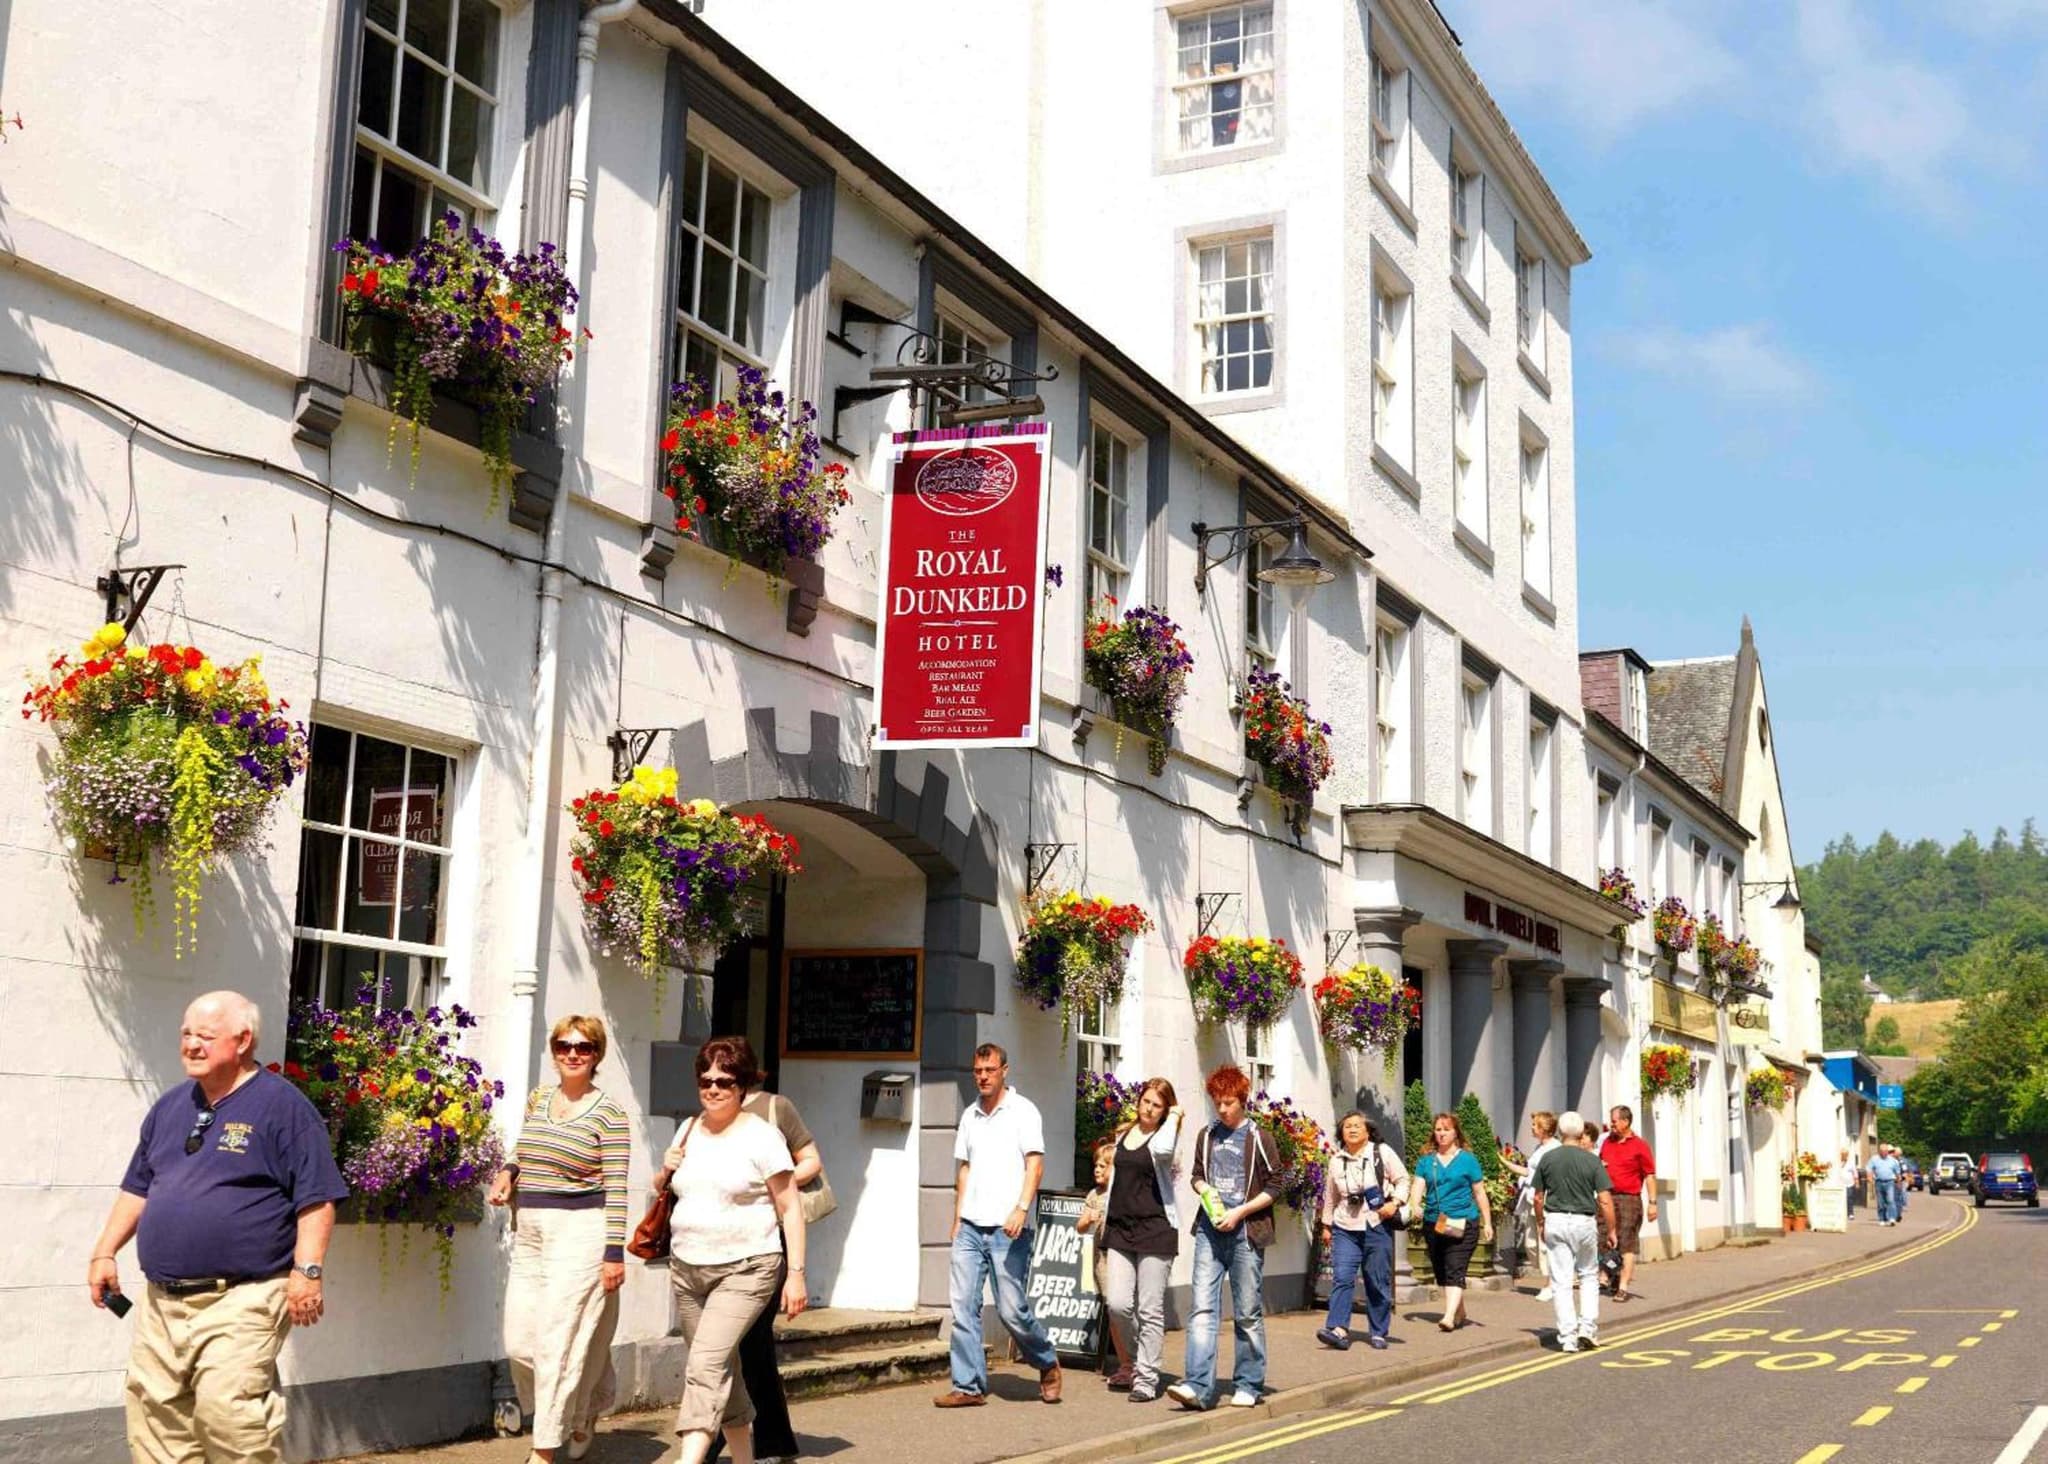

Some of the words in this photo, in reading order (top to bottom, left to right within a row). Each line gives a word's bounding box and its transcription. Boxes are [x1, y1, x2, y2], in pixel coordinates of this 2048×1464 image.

[948, 529, 976, 540] THE
[915, 548, 1007, 577] ROYAL
[893, 585, 1028, 616] DUNKELD
[918, 634, 998, 652] HOTEL
[918, 659, 997, 670] ACCOMMODATION
[929, 671, 985, 681] RESTAURANT
[932, 684, 950, 693] BAR
[951, 683, 981, 693] MEALS
[935, 695, 958, 705] REAL
[960, 695, 977, 705] ALE
[923, 708, 946, 718] BEER
[947, 707, 987, 718] GARDEN
[947, 725, 963, 734] ALL
[965, 725, 989, 733] YEAR
[1033, 1223, 1081, 1268] LARGE
[1029, 1274, 1077, 1298] BEER
[1034, 1296, 1101, 1319] GARDEN
[1047, 1327, 1089, 1346] REAR
[1688, 1328, 1917, 1344] BUS
[1601, 1350, 1928, 1371] STOP
